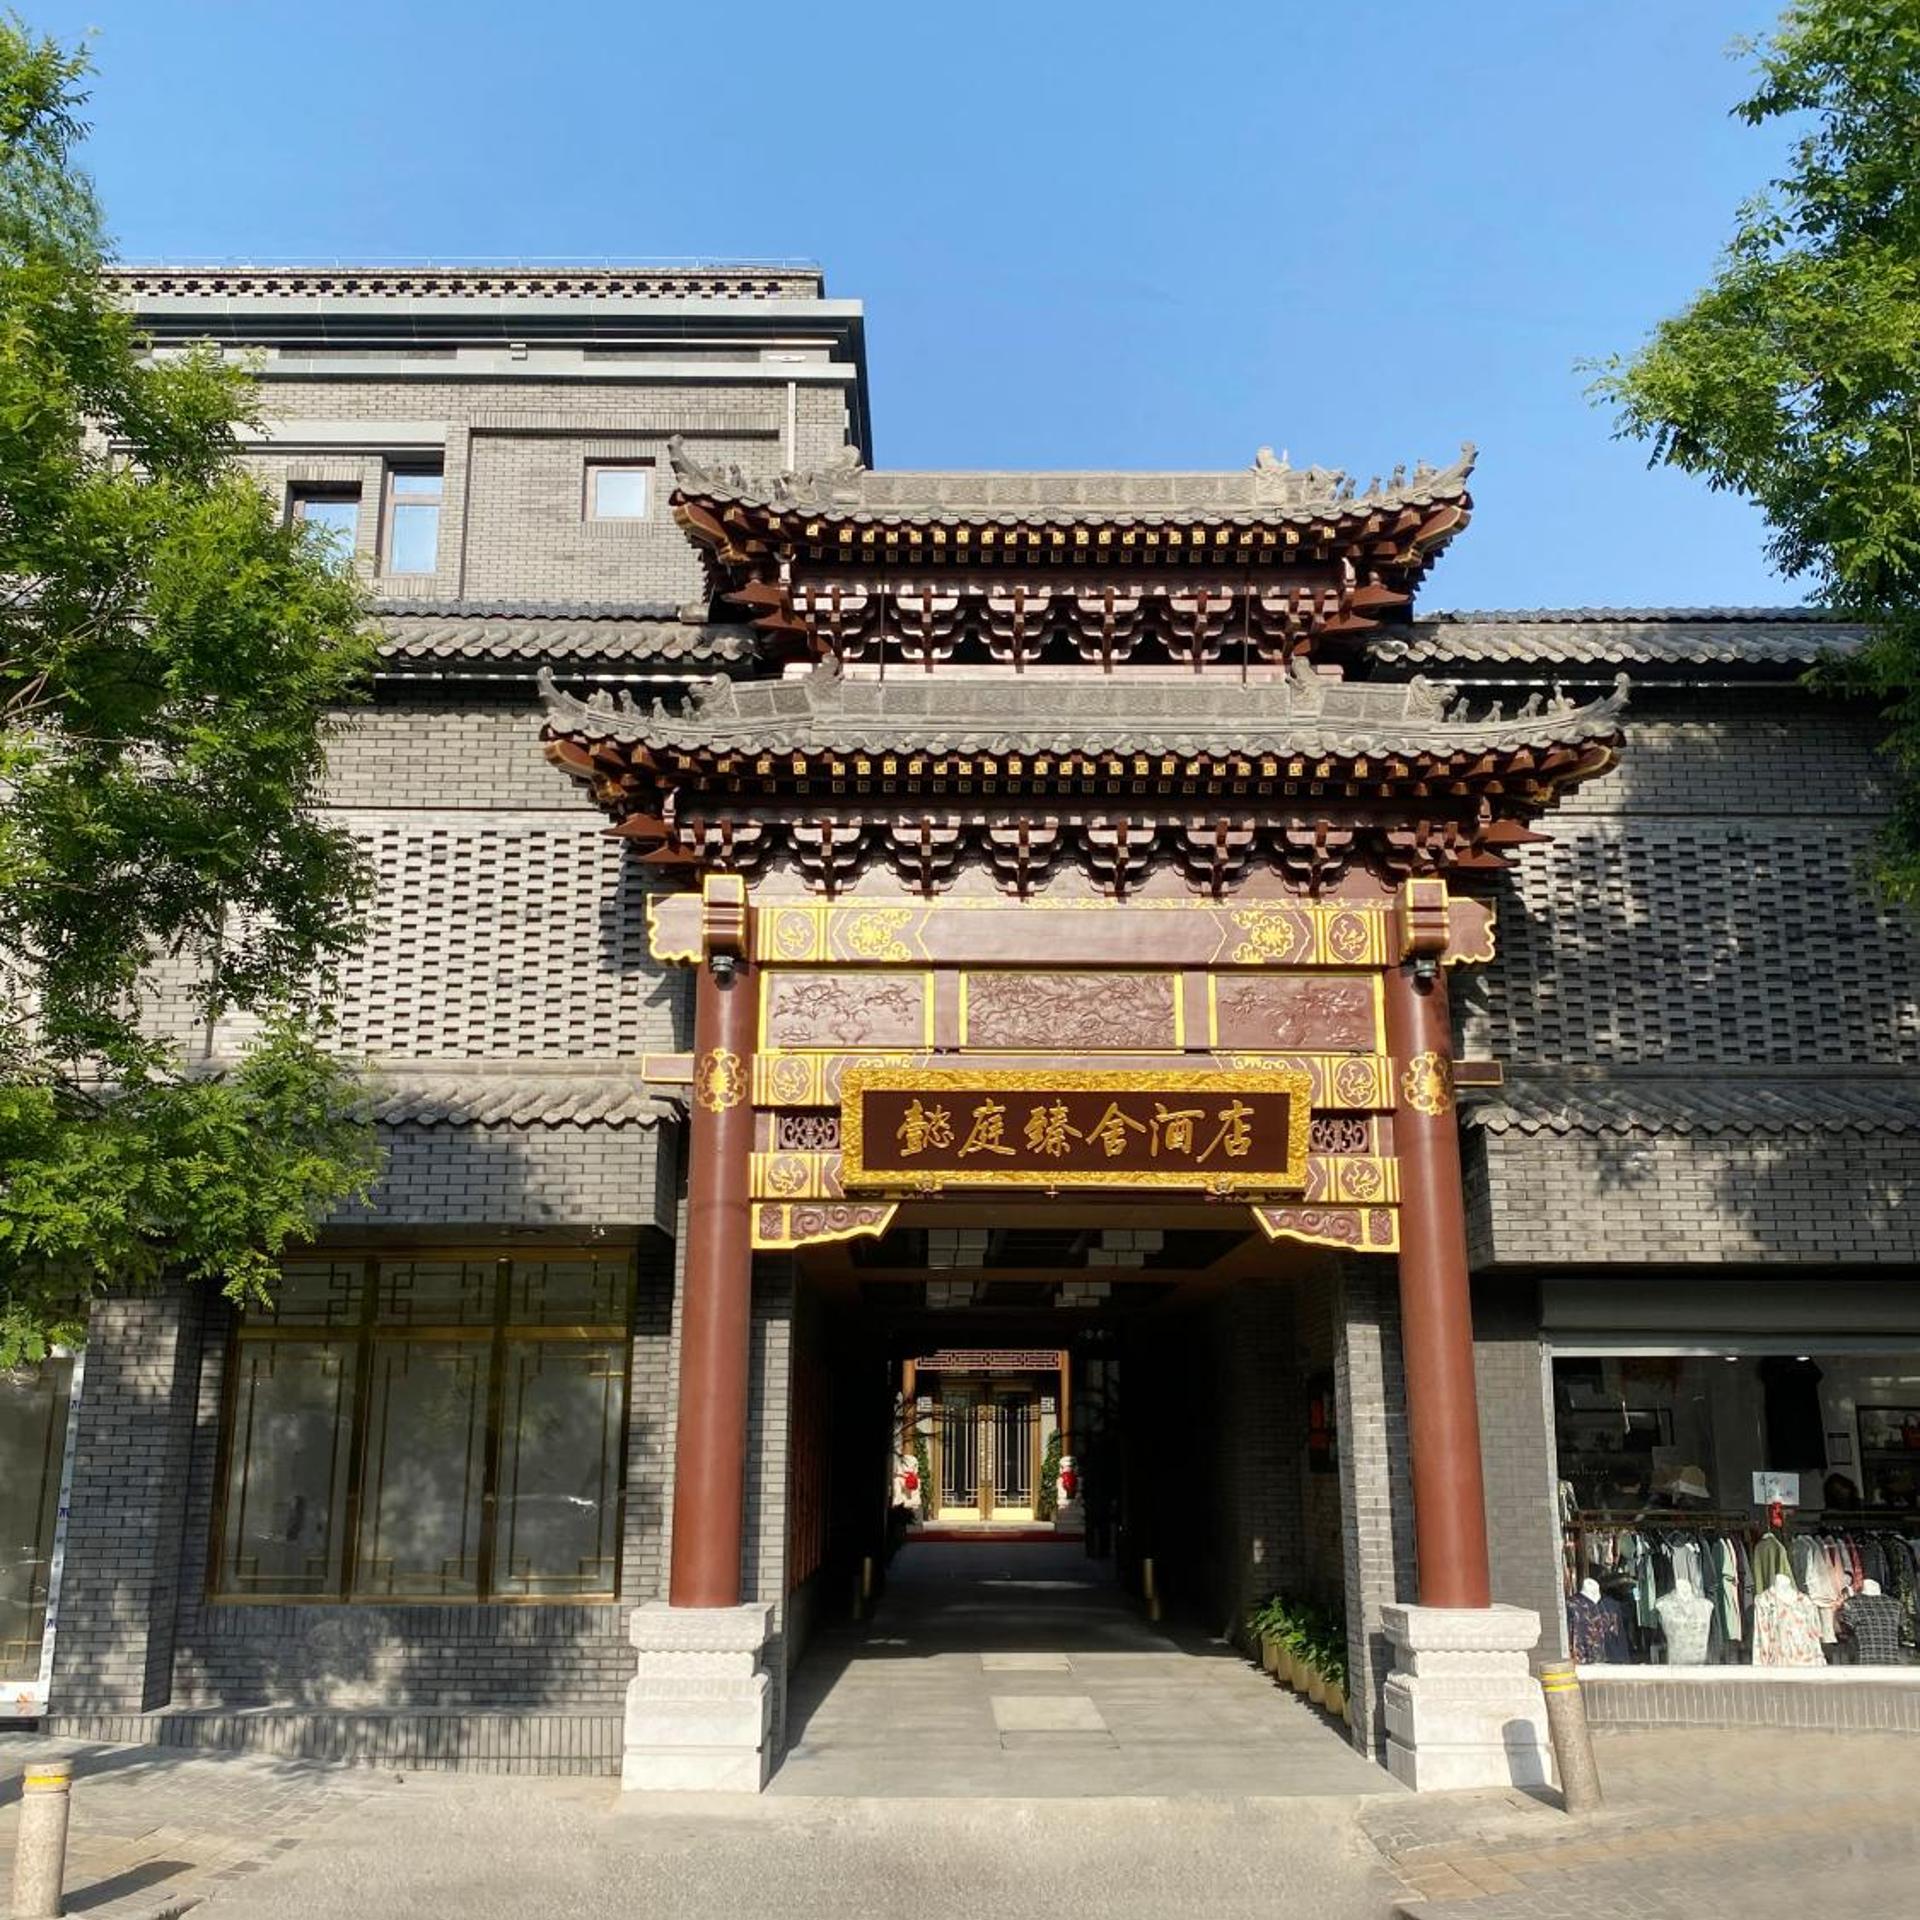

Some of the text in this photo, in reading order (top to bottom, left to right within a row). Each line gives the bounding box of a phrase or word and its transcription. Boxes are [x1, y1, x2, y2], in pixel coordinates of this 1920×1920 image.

[896, 1098, 1255, 1162] 懿庭臻舍酒店
